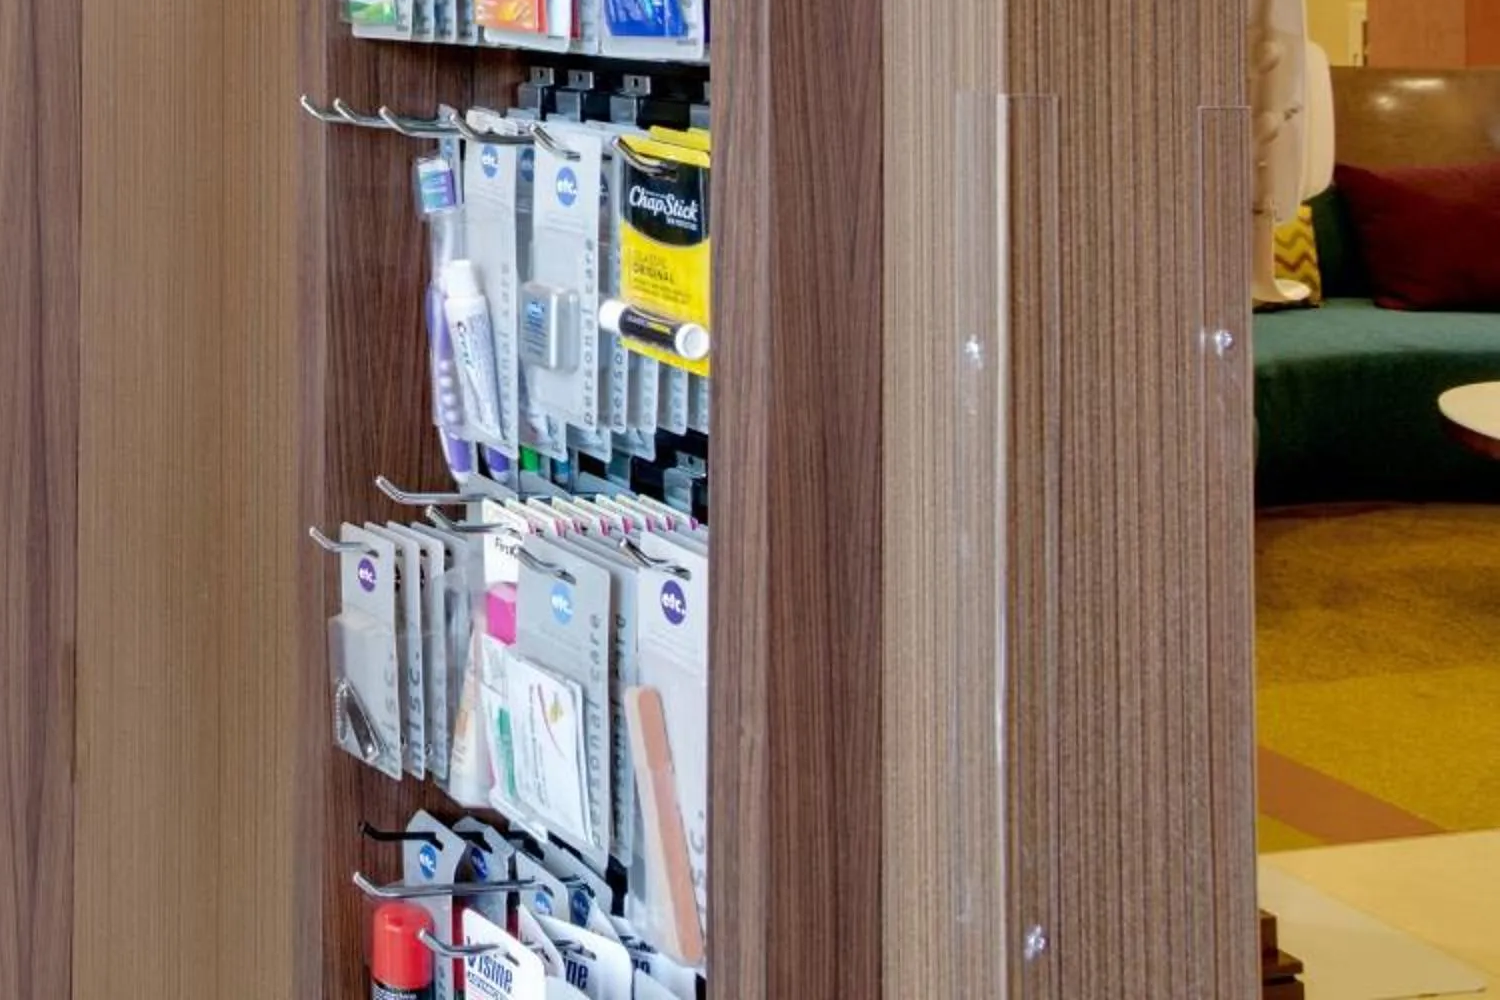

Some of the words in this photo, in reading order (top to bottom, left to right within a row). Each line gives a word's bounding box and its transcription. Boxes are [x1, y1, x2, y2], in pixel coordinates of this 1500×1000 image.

[557, 177, 578, 195] etc.
[629, 184, 699, 223] ChapStick
[582, 307, 594, 427] personal
[466, 937, 513, 995] Visine
